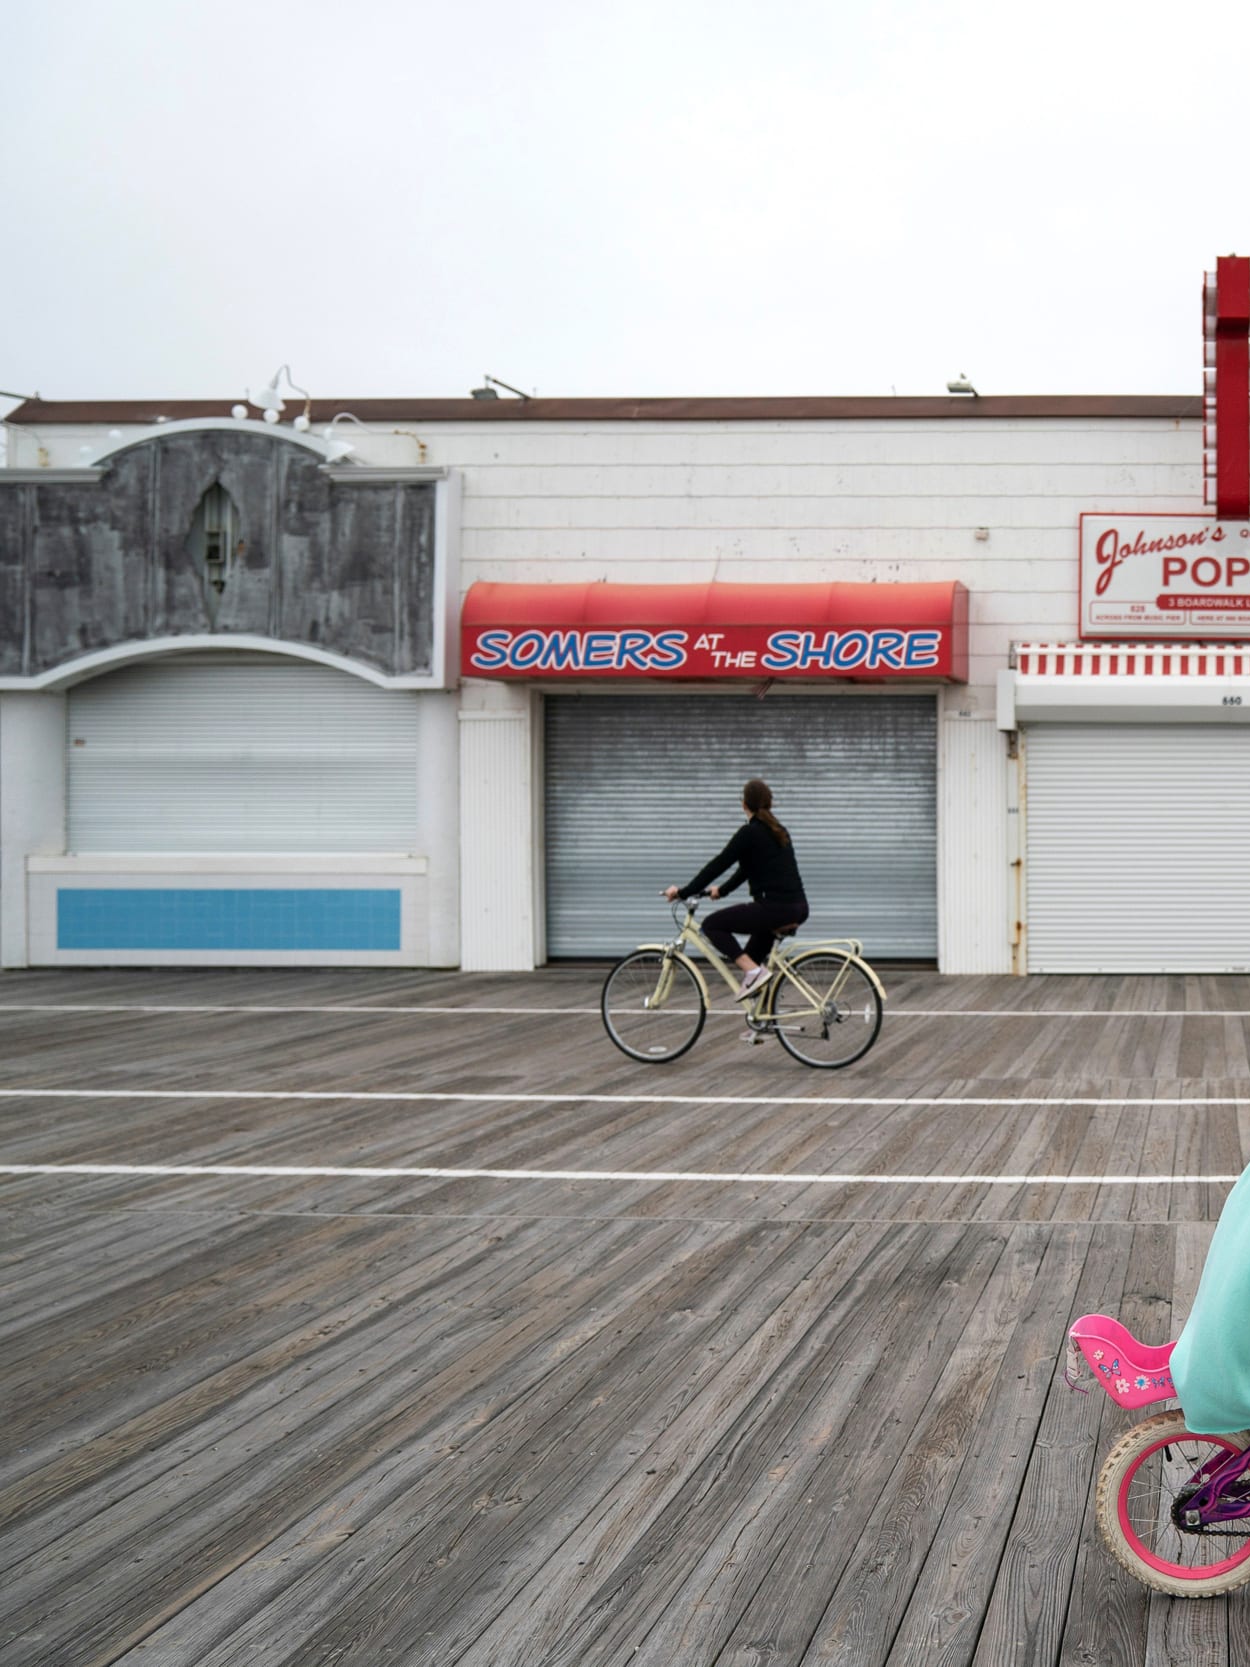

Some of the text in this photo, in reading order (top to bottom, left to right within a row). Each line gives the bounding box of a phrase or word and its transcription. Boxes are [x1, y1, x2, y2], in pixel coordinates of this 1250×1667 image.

[1095, 525, 1227, 596] Johnson's
[1168, 597, 1175, 607] 3
[1177, 598, 1243, 608] BOARDWALK
[470, 630, 943, 670] SOMERS AT THE SHORE
